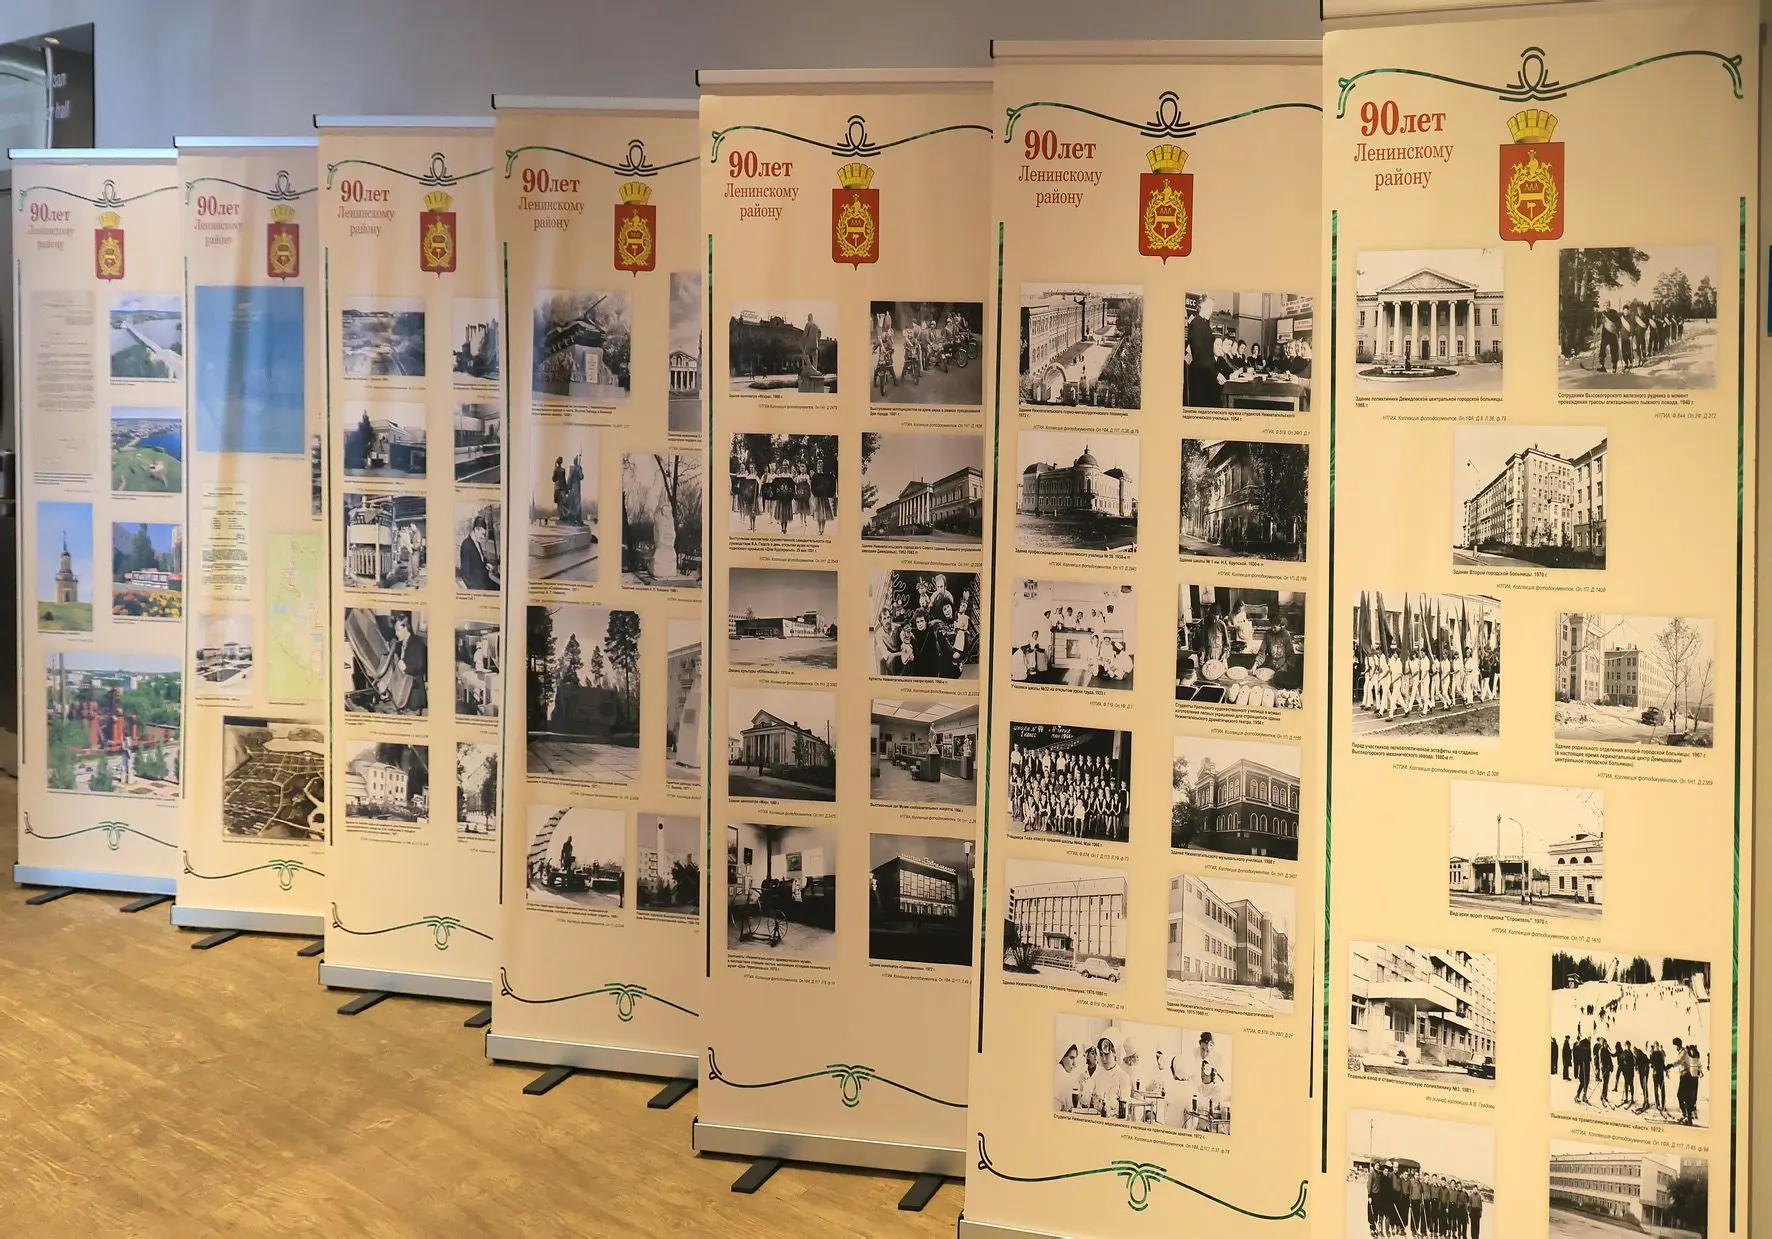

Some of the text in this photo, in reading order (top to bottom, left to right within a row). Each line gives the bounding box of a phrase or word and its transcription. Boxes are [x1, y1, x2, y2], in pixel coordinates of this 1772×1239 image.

[1360, 100, 1446, 136] 90лет
[1024, 130, 1096, 160] 90лет
[1354, 142, 1454, 163] Ленинскому
[729, 150, 793, 178] 90лет
[522, 168, 580, 192] 90лет
[1019, 165, 1102, 185] Ленинскому
[1374, 168, 1432, 190] району
[340, 180, 390, 202] 90лет
[724, 183, 799, 201] Ленинскому
[1036, 188, 1083, 208] району
[30, 202, 70, 222] 90лет
[197, 195, 239, 216] 90лет
[337, 206, 394, 220] Ленинскому
[518, 197, 584, 213] Ленинскому
[740, 204, 782, 220] району
[350, 223, 381, 236] району
[534, 216, 569, 231] району
